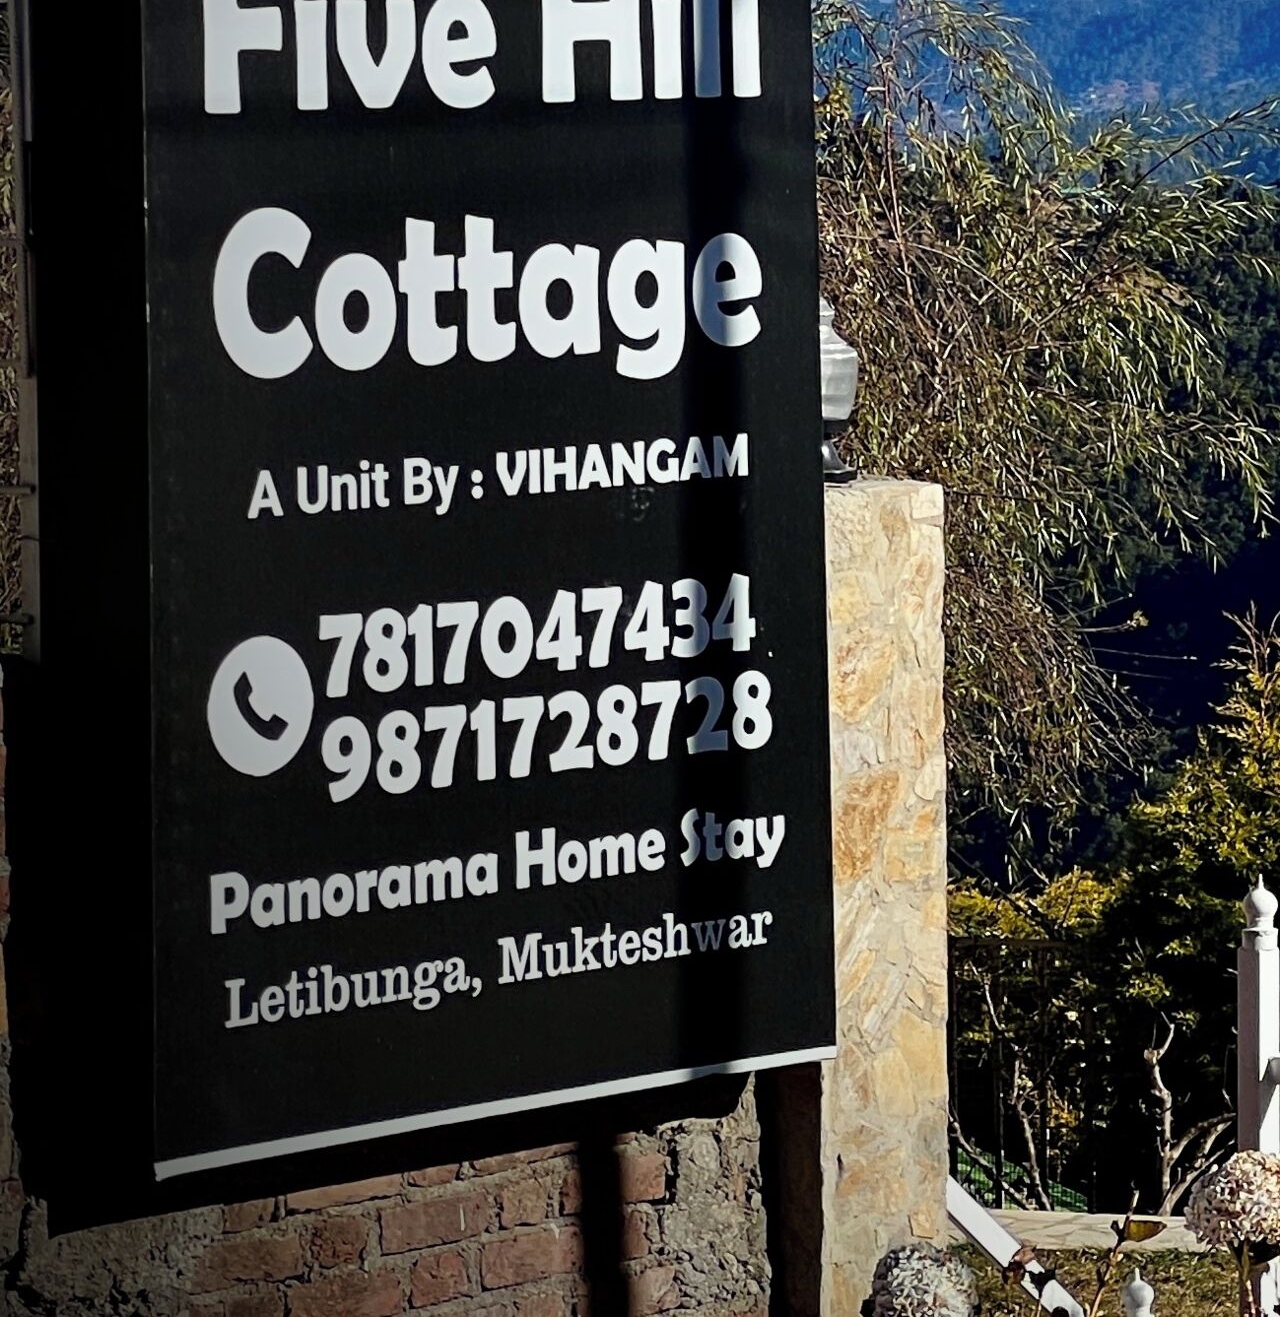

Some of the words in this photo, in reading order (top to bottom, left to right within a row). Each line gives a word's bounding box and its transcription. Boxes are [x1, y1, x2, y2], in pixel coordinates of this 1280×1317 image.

[213, 207, 762, 380] Cottage
[248, 469, 283, 520] A
[297, 460, 389, 514] Unit
[404, 456, 459, 516] By
[496, 433, 750, 496] VIHANGAM
[318, 573, 756, 698] 7817047434
[321, 670, 773, 803] 9871728728
[209, 851, 497, 935] Panorama
[515, 826, 666, 889] Home
[680, 808, 786, 867] Stay
[224, 955, 483, 1029] Letibunga,
[498, 910, 773, 985] Mukteshwar
